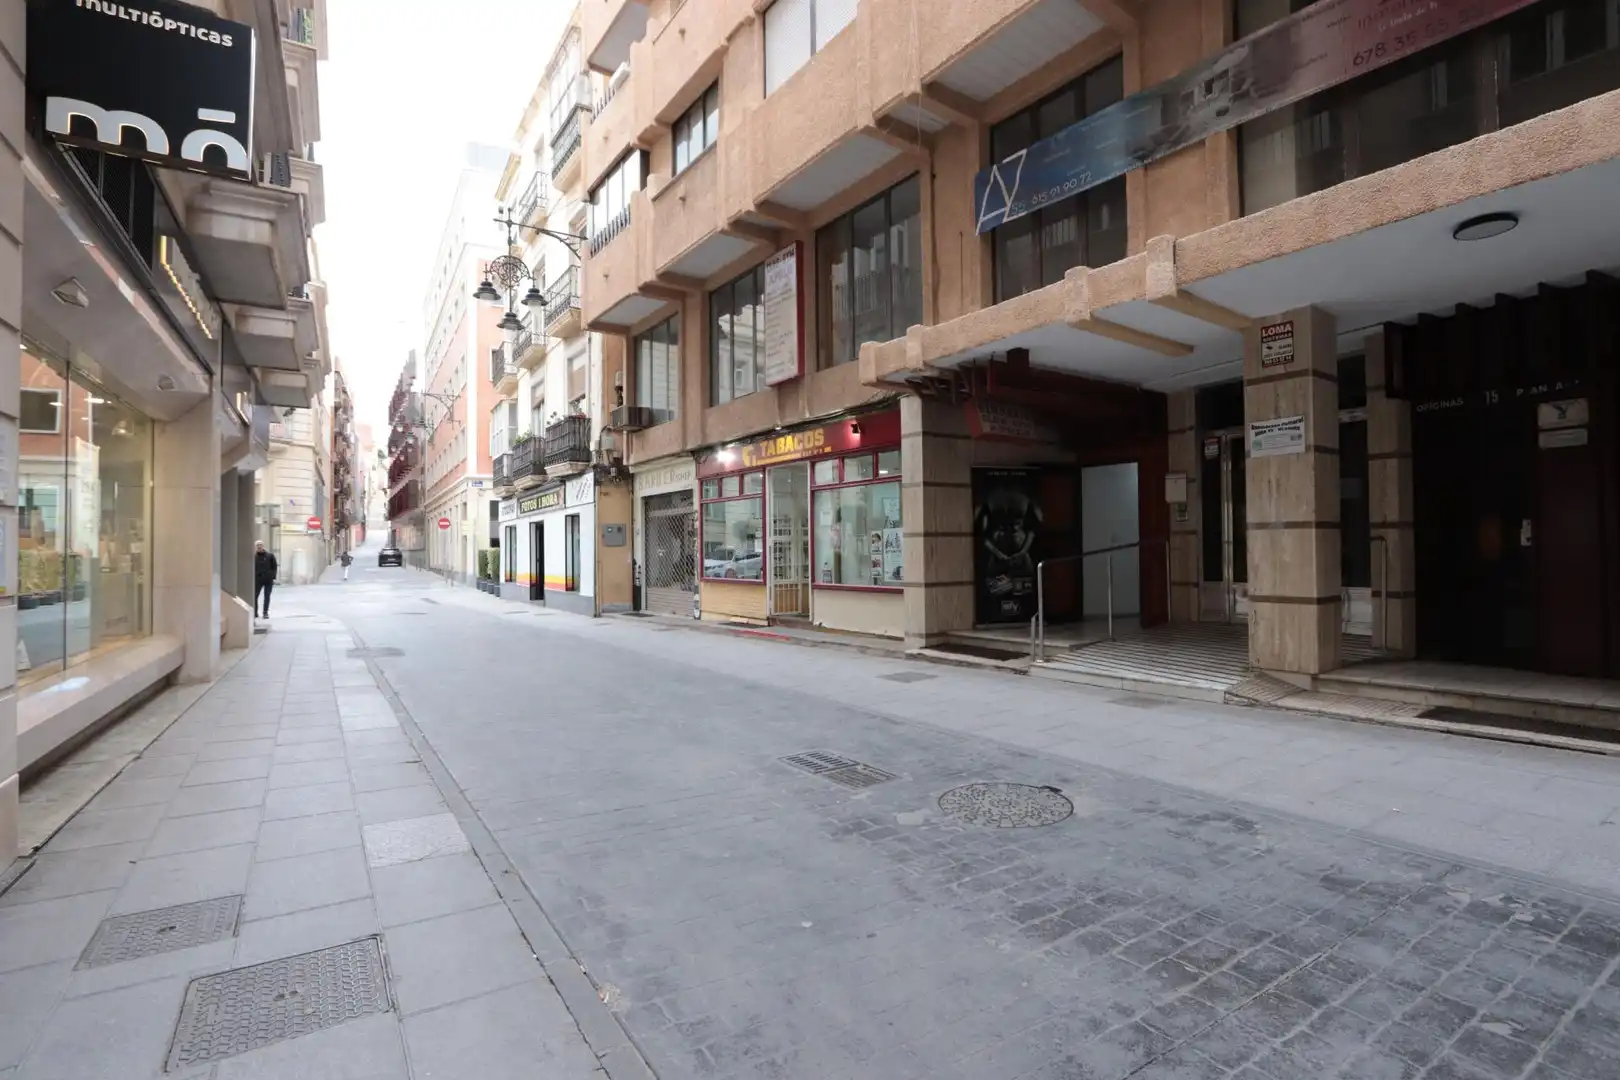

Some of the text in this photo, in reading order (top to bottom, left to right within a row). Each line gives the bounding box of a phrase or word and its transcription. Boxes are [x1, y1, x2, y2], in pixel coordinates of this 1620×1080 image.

[1352, 42, 1387, 66] 678
[1394, 31, 1418, 52] 35
[1261, 323, 1292, 337] LOMA
[1415, 397, 1465, 413] OFICINAS
[1483, 389, 1500, 406] 15
[759, 427, 825, 457] TABACOS
[541, 491, 559, 507] HORA
